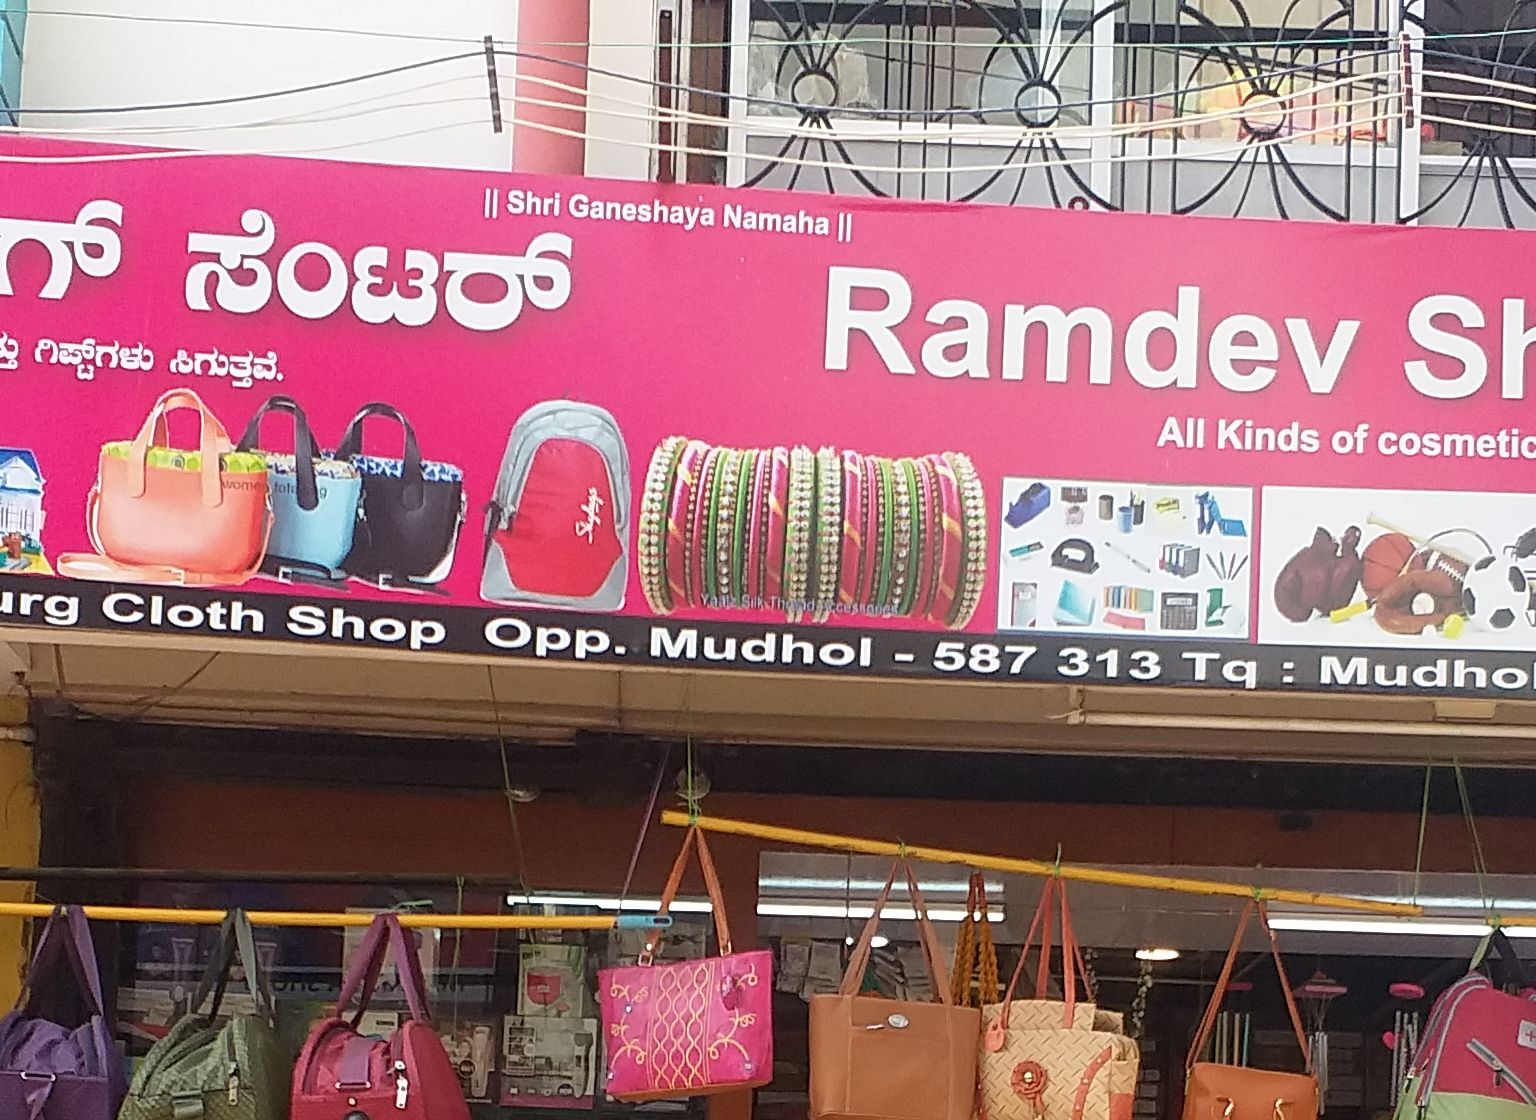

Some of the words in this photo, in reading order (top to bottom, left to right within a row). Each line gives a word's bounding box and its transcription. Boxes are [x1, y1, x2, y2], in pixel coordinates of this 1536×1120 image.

[506, 189, 561, 217] Shri
[568, 193, 715, 231] Ganeshaya
[723, 204, 830, 236] Namaha
[185, 208, 574, 332] ಸೆಂಟರ್
[824, 266, 1361, 394] Ramdev
[1156, 415, 1206, 448] All
[1217, 418, 1321, 453] Kinds
[1331, 423, 1370, 454] of
[100, 587, 264, 632] Cloth
[286, 605, 446, 650] Shop
[480, 617, 626, 659] Opp.
[650, 615, 872, 661] Mudhol
[933, 641, 1037, 674] 587
[1057, 647, 1161, 680] 313
[1181, 651, 1257, 689] Tq
[1282, 661, 1295, 683] :
